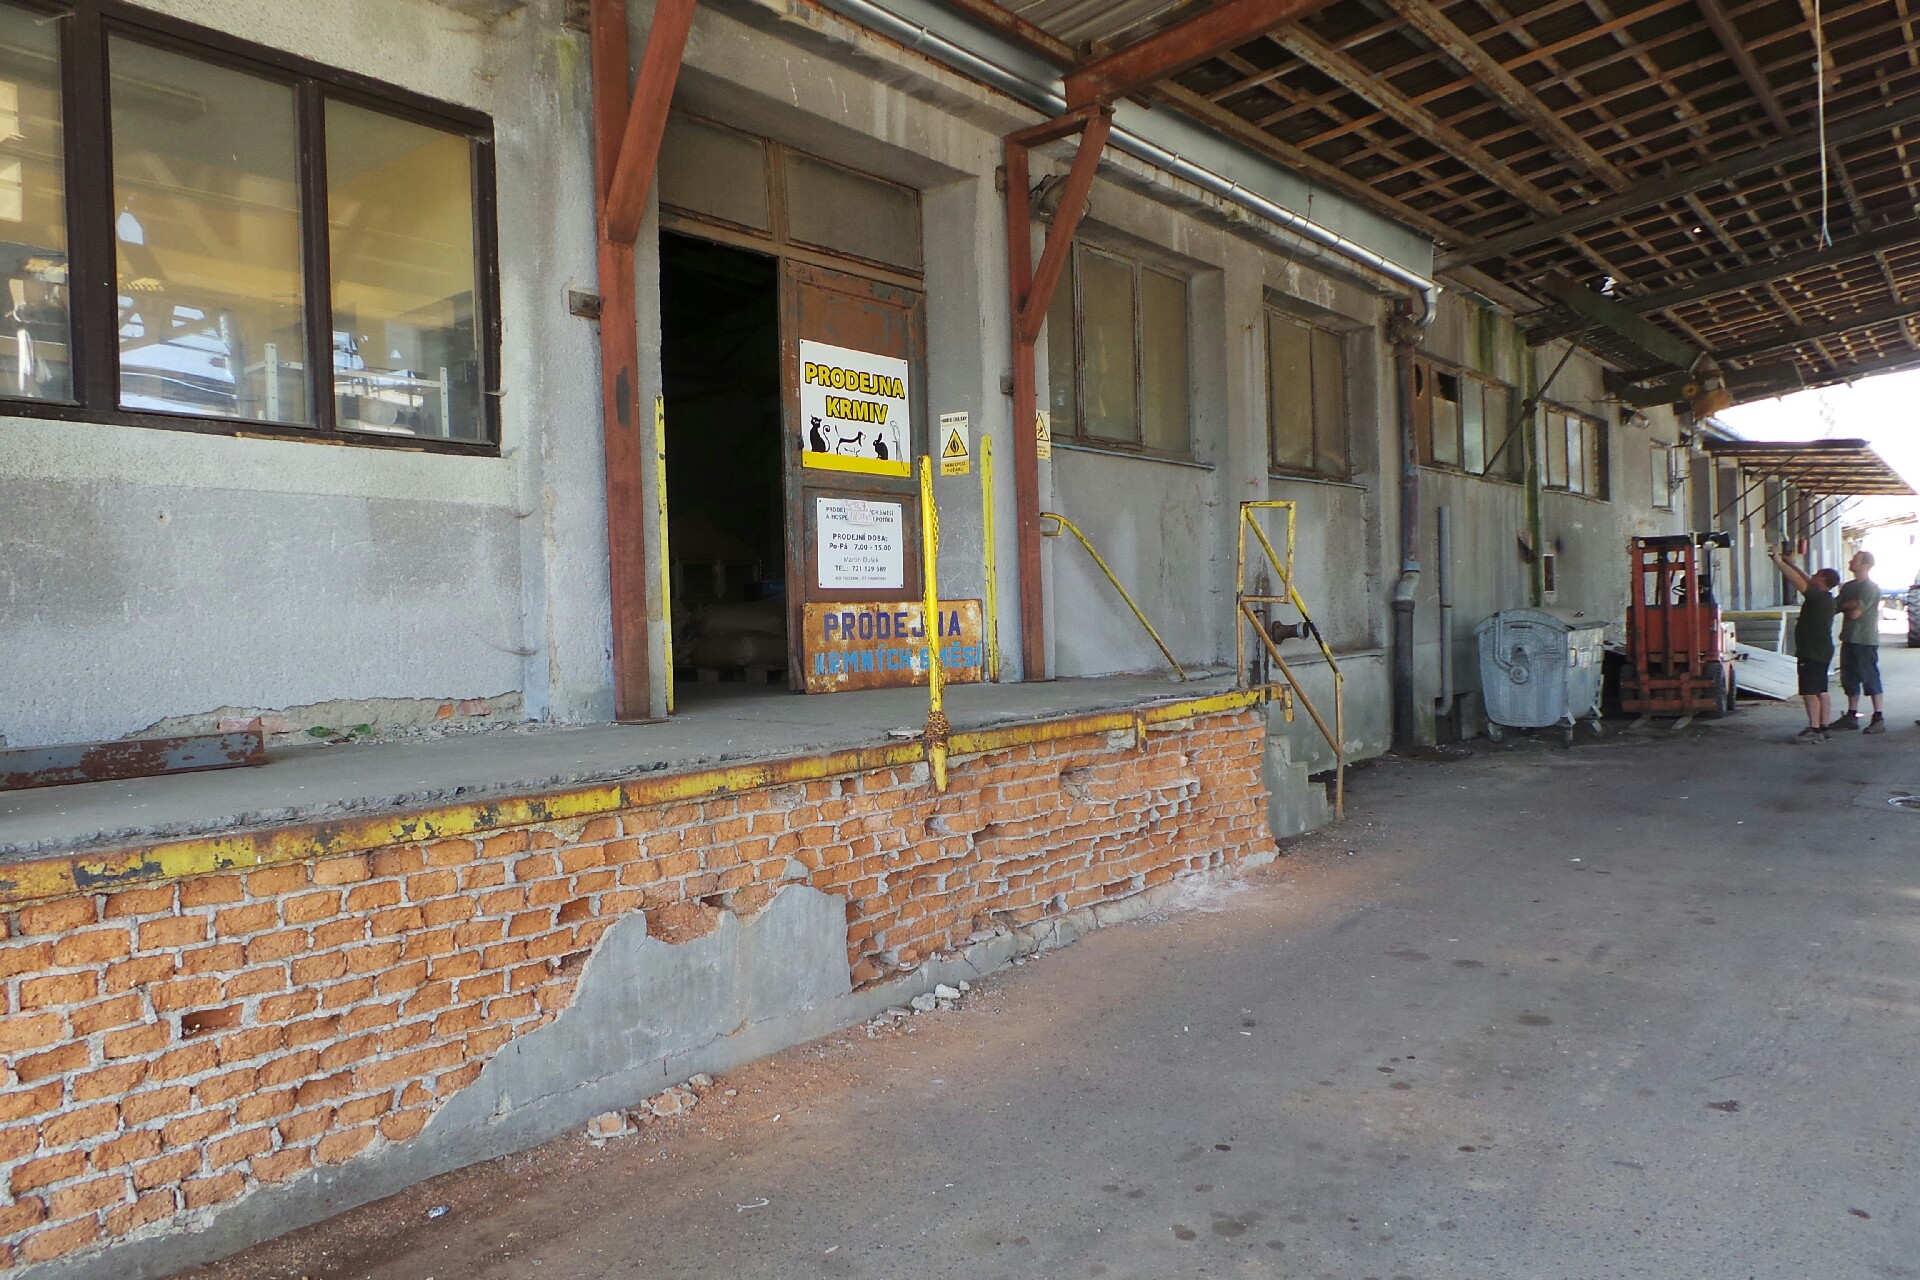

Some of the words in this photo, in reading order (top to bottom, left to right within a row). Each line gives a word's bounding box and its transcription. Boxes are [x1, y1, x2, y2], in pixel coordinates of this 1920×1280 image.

[805, 362, 905, 399] PRODEJNA
[826, 395, 888, 425] KRMIV
[832, 533, 866, 541] PRODEJNÍ
[815, 644, 911, 676] KRMNÝCH
